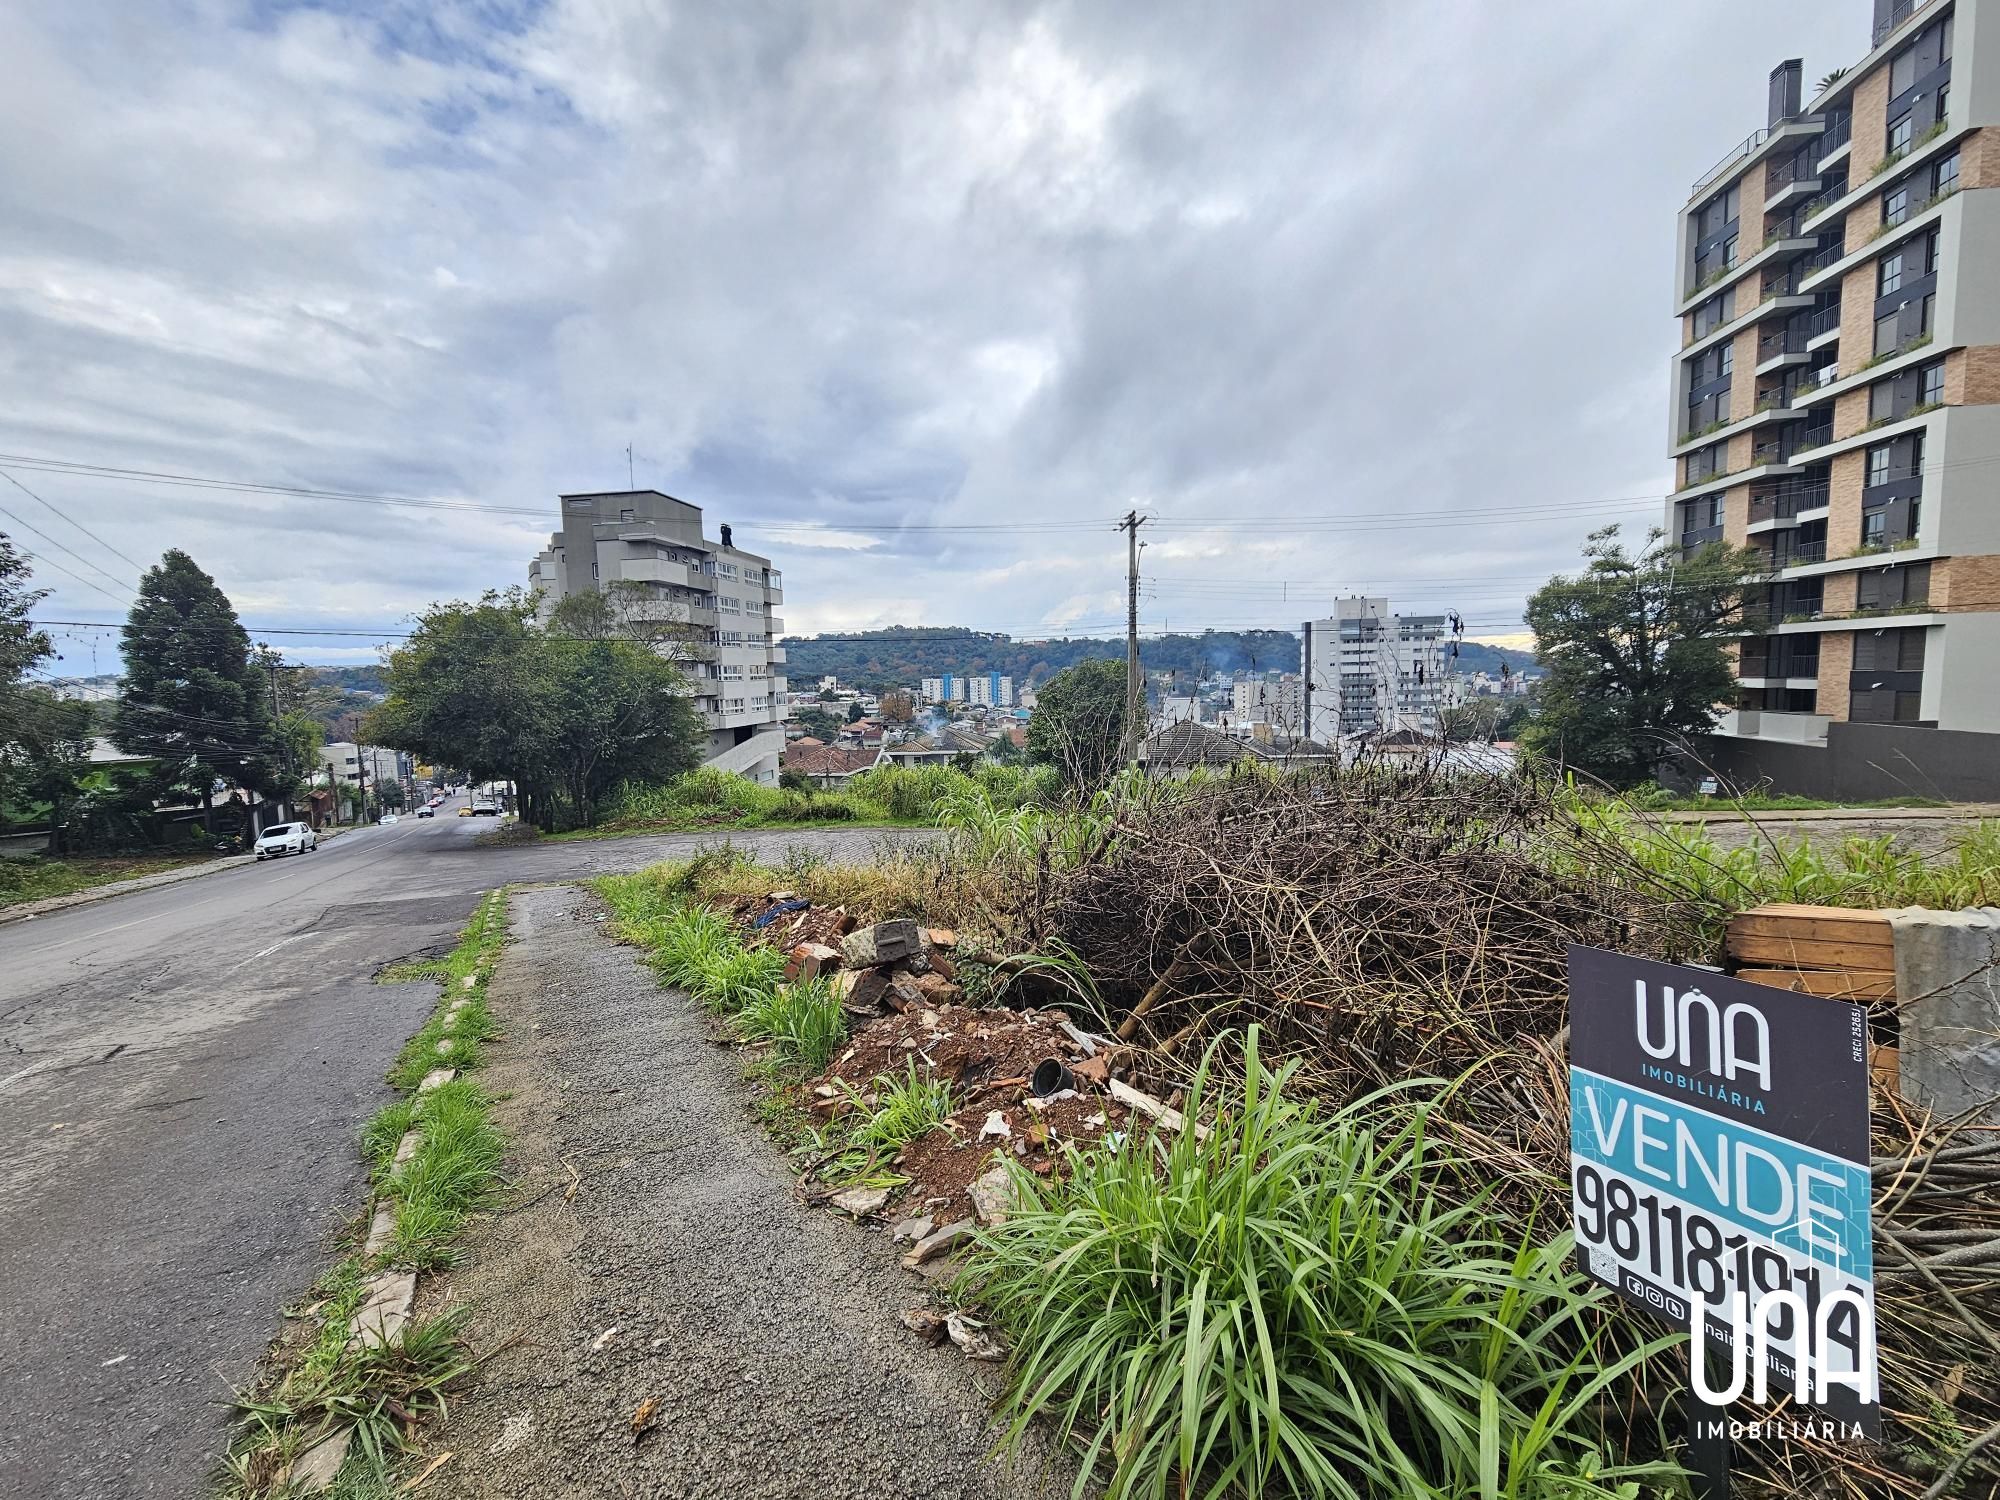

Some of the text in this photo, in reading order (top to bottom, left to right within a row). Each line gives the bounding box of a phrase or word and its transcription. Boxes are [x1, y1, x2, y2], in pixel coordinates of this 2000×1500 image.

[1635, 979, 1771, 1092] UNA
[1851, 1007, 1863, 1063] CRECI 25265J
[1642, 1063, 1766, 1115] IMOBILIÁRIA
[1584, 1085, 1849, 1257] VENDE
